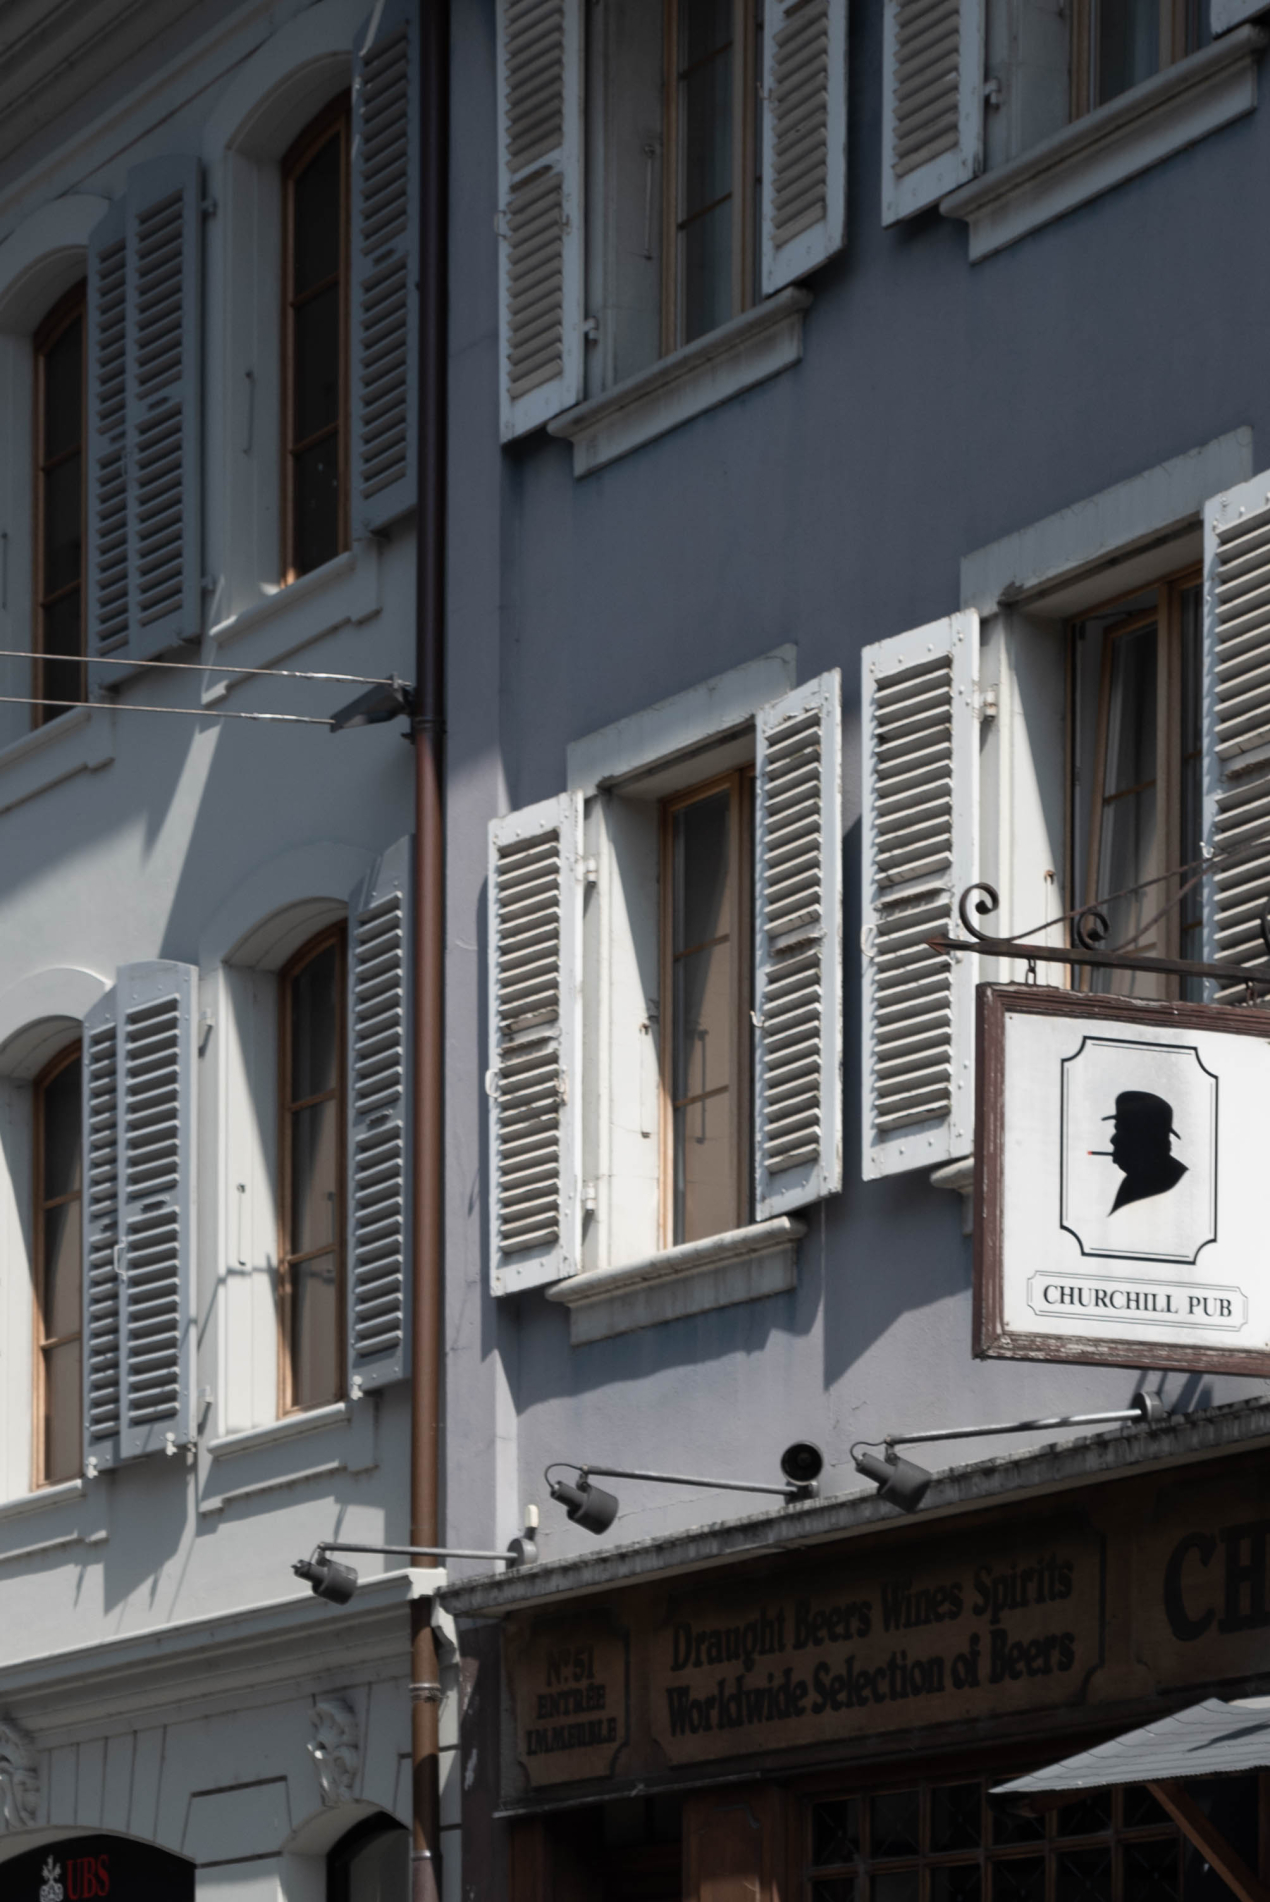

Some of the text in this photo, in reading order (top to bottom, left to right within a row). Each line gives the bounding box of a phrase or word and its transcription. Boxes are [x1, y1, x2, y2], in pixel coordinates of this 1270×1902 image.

[1043, 1284, 1232, 1318] CHURCHILL PUB
[671, 1551, 1074, 1672] Draught Beers Wines Spirits
[1163, 1518, 1270, 1642] CH
[536, 1682, 606, 1719] ENTRÉE
[667, 1628, 1076, 1738] Worldwide Selection of Beers
[66, 1853, 111, 1901] UBS
